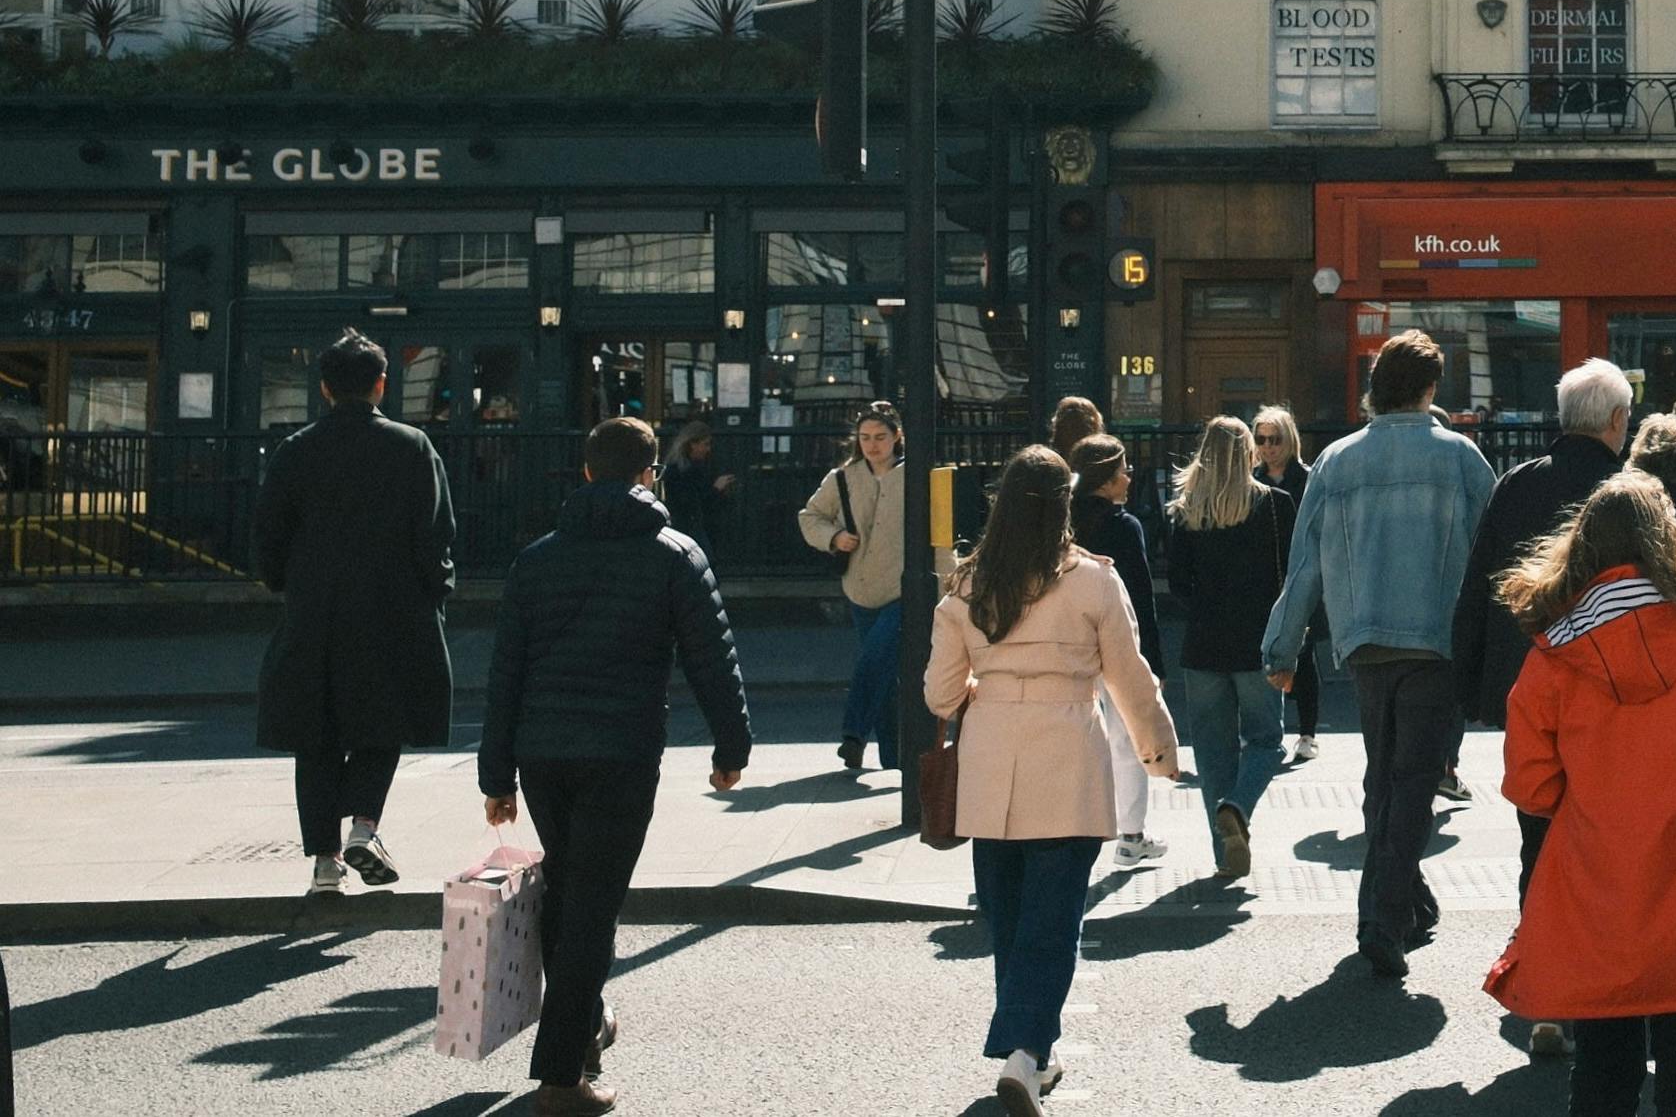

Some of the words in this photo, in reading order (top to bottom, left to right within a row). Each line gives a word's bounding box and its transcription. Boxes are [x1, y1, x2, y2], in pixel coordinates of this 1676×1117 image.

[1278, 8, 1370, 28] BLOOD
[1530, 10, 1623, 27] DERMAL
[1290, 47, 1376, 68] TESTS
[1530, 47, 1625, 65] FILLERS
[151, 148, 252, 182] THE
[272, 147, 442, 182] GLOBE
[1414, 234, 1501, 253] kfh.co.uk
[1124, 255, 1145, 283] 15
[1053, 362, 1086, 370] GLOBE
[1120, 355, 1155, 376] 136
